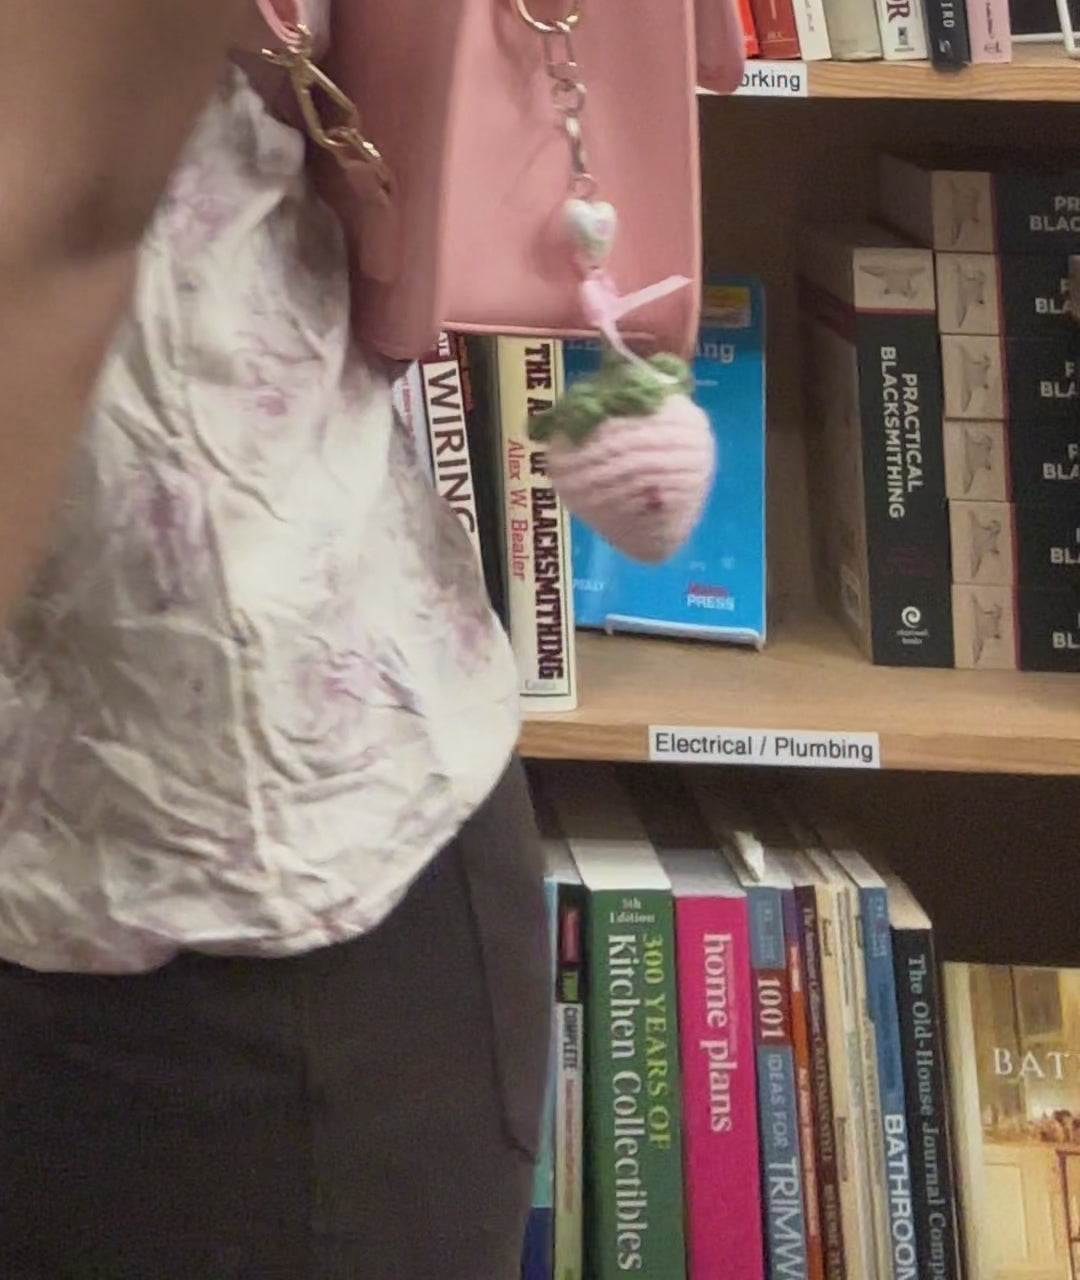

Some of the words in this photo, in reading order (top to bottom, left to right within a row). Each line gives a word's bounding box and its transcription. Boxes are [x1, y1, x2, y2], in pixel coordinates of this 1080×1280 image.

[525, 343, 552, 390] THE
[507, 438, 525, 480] Alex
[880, 345, 905, 520] BLACKSMITHING
[902, 373, 924, 493] PRACTICAL
[510, 488, 528, 511] W.
[511, 518, 529, 581] Bealer
[531, 487, 564, 681] BLACKSMITHING
[686, 596, 735, 612] PRESS
[654, 732, 753, 757] Electrical
[759, 736, 768, 756] /
[773, 737, 874, 764] Plumbing
[642, 933, 665, 986] 300
[702, 932, 733, 1028] home
[907, 953, 926, 995] The
[608, 933, 642, 1059] Kitchen
[757, 978, 785, 1039] 1001
[644, 993, 669, 1096] YEARS
[912, 1001, 934, 1116] Old-House
[700, 1039, 738, 1133] plans
[767, 1054, 786, 1105] IDEAS
[648, 1105, 671, 1150] OF
[771, 1111, 789, 1148] FOR
[612, 1069, 649, 1271] Collectibles
[920, 1121, 947, 1207] Journal
